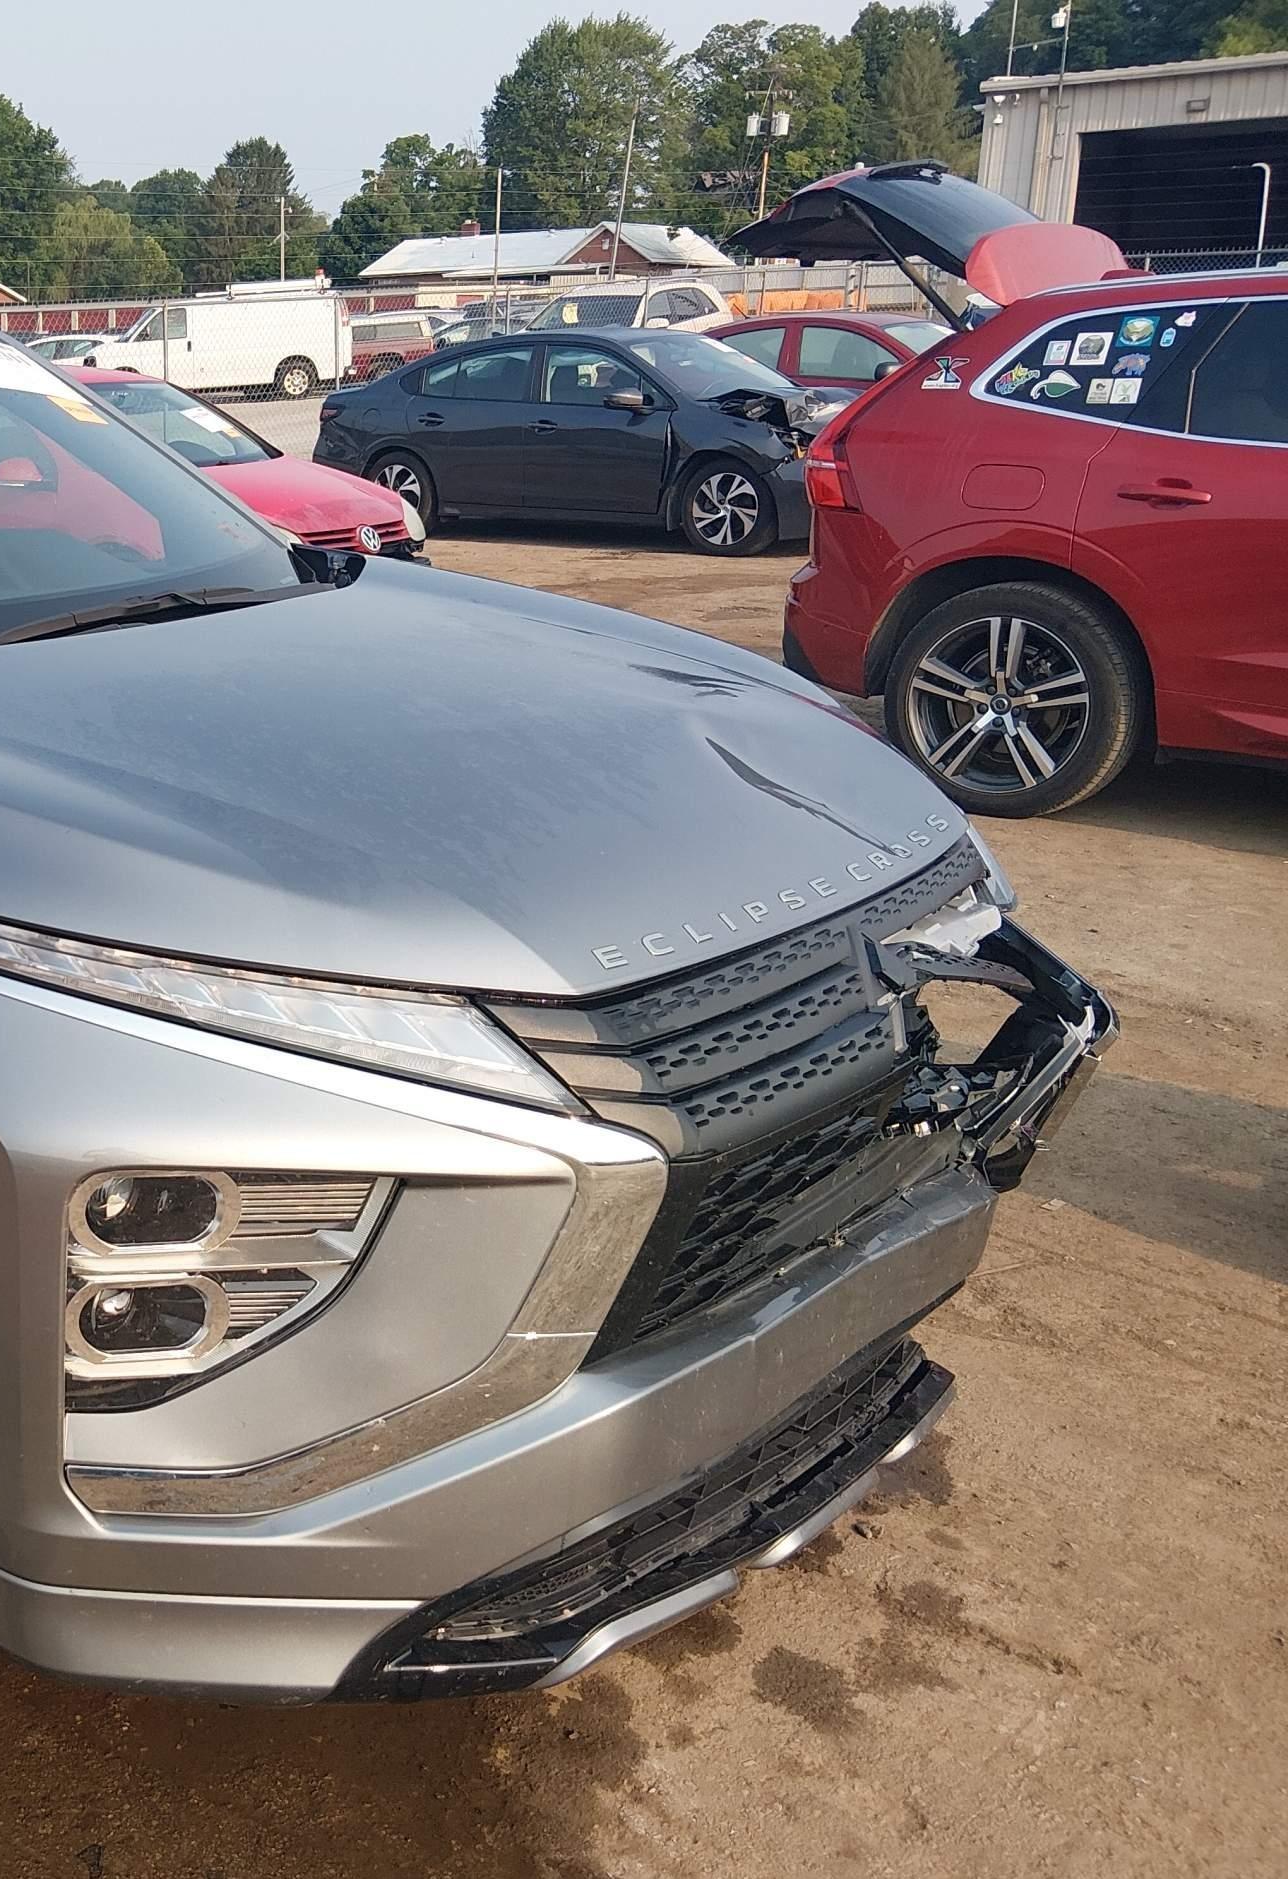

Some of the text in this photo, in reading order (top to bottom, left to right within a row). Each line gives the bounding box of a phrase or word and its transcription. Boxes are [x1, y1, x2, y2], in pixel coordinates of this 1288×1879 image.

[361, 526, 381, 551] VW
[591, 813, 949, 969] ECLIPSE CROSS
